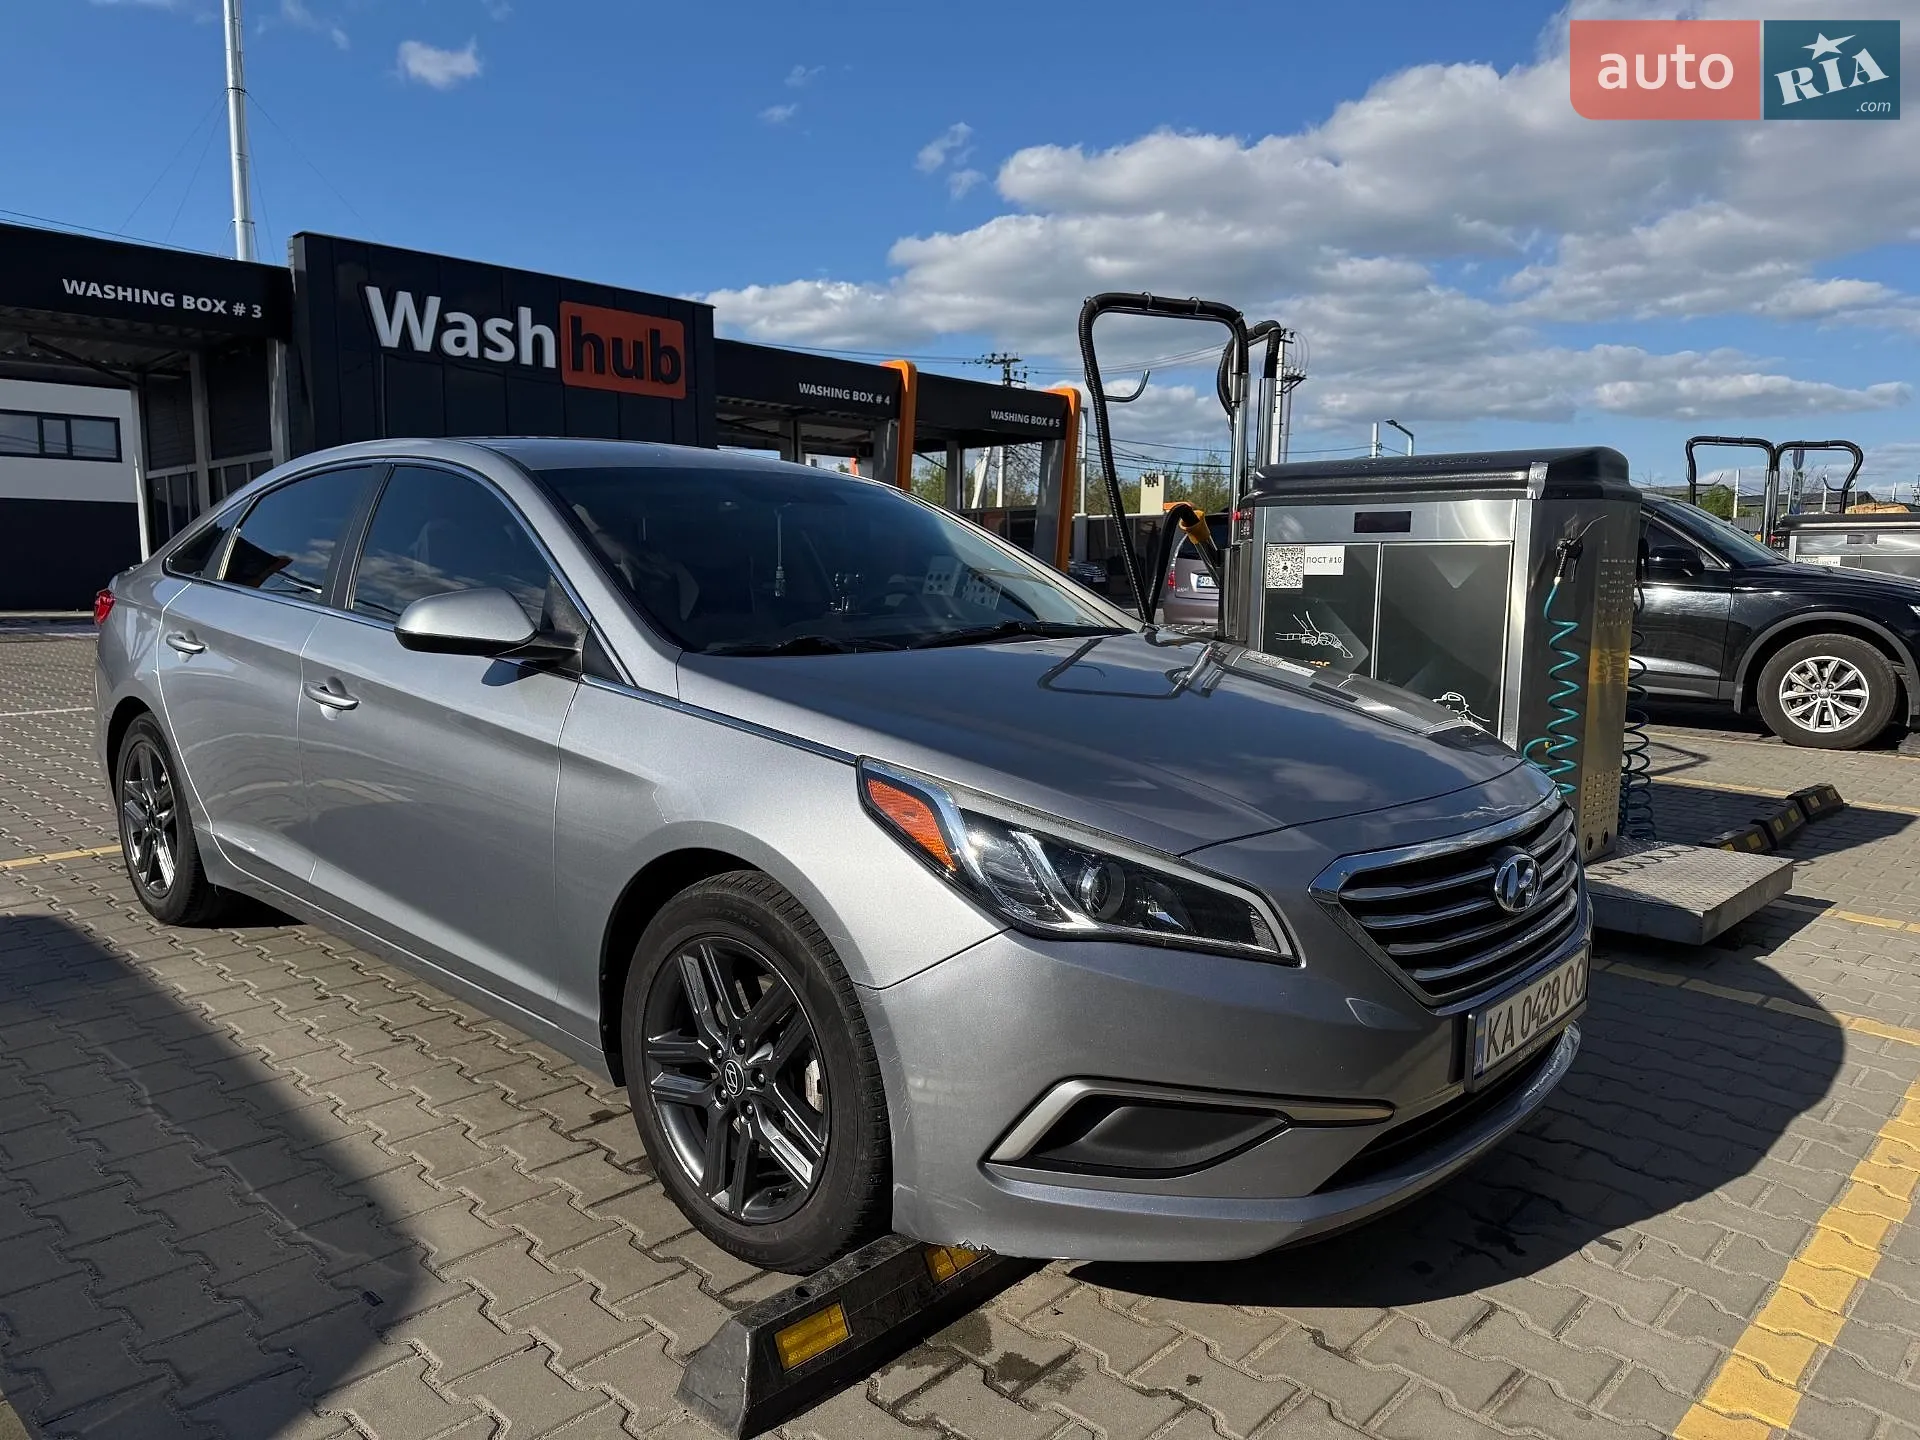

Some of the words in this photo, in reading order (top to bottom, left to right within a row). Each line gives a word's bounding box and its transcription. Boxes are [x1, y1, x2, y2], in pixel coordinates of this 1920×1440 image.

[62, 278, 176, 308] WASHING
[182, 295, 228, 315] BOX
[232, 302, 246, 317] #
[251, 304, 263, 319] 3
[364, 285, 557, 369] Wash
[569, 314, 682, 386] hub
[798, 382, 850, 400] WASHING
[852, 390, 874, 404] BOX
[884, 395, 891, 405] 4
[990, 409, 1030, 424] WASHING
[1030, 415, 1048, 427] BOX
[1055, 418, 1061, 428] 5
[1486, 1004, 1515, 1063] KA
[1521, 976, 1561, 1039] 0428
